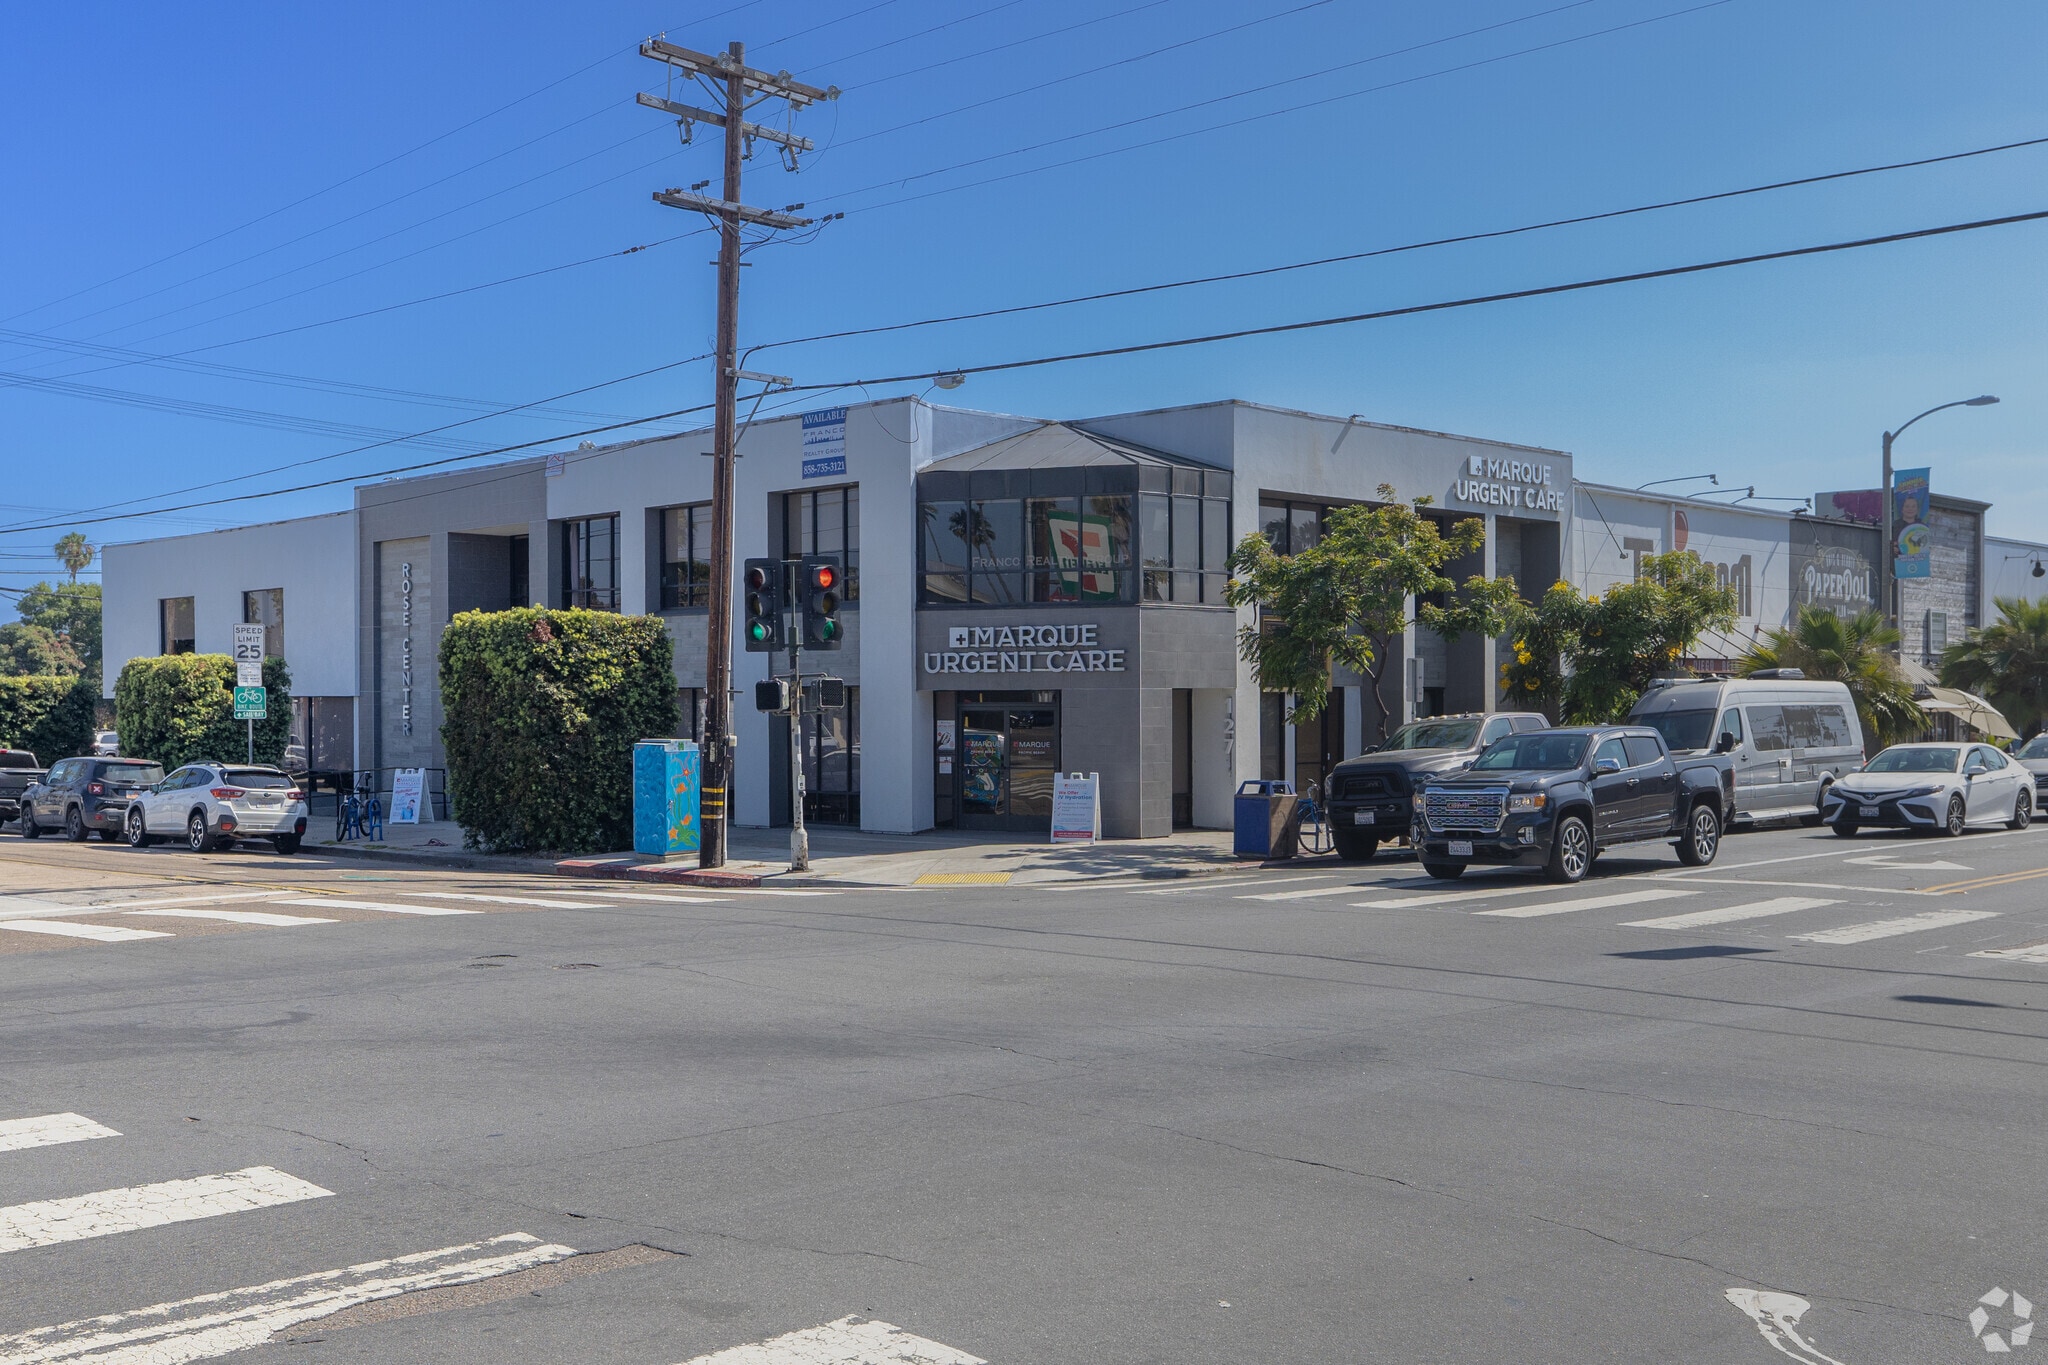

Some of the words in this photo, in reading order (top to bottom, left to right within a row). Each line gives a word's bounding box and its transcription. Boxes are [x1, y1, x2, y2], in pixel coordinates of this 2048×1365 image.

[803, 409, 846, 425] AVAILABLE
[803, 427, 845, 437] FRANCO
[825, 447, 846, 455] GROUP
[803, 461, 845, 475] 858-735-3121
[1487, 457, 1552, 486] MARQUE
[1457, 479, 1521, 507] URGENT
[1525, 487, 1565, 512] CARE
[971, 556, 1021, 568] FRANCO
[402, 562, 412, 627] ROSE
[974, 624, 1098, 648] MARQUE
[237, 644, 261, 659] 25
[924, 651, 1037, 674] URGENT
[1046, 649, 1125, 673] CARE
[402, 638, 412, 737] CENTER
[970, 740, 1001, 748] MARQUE
